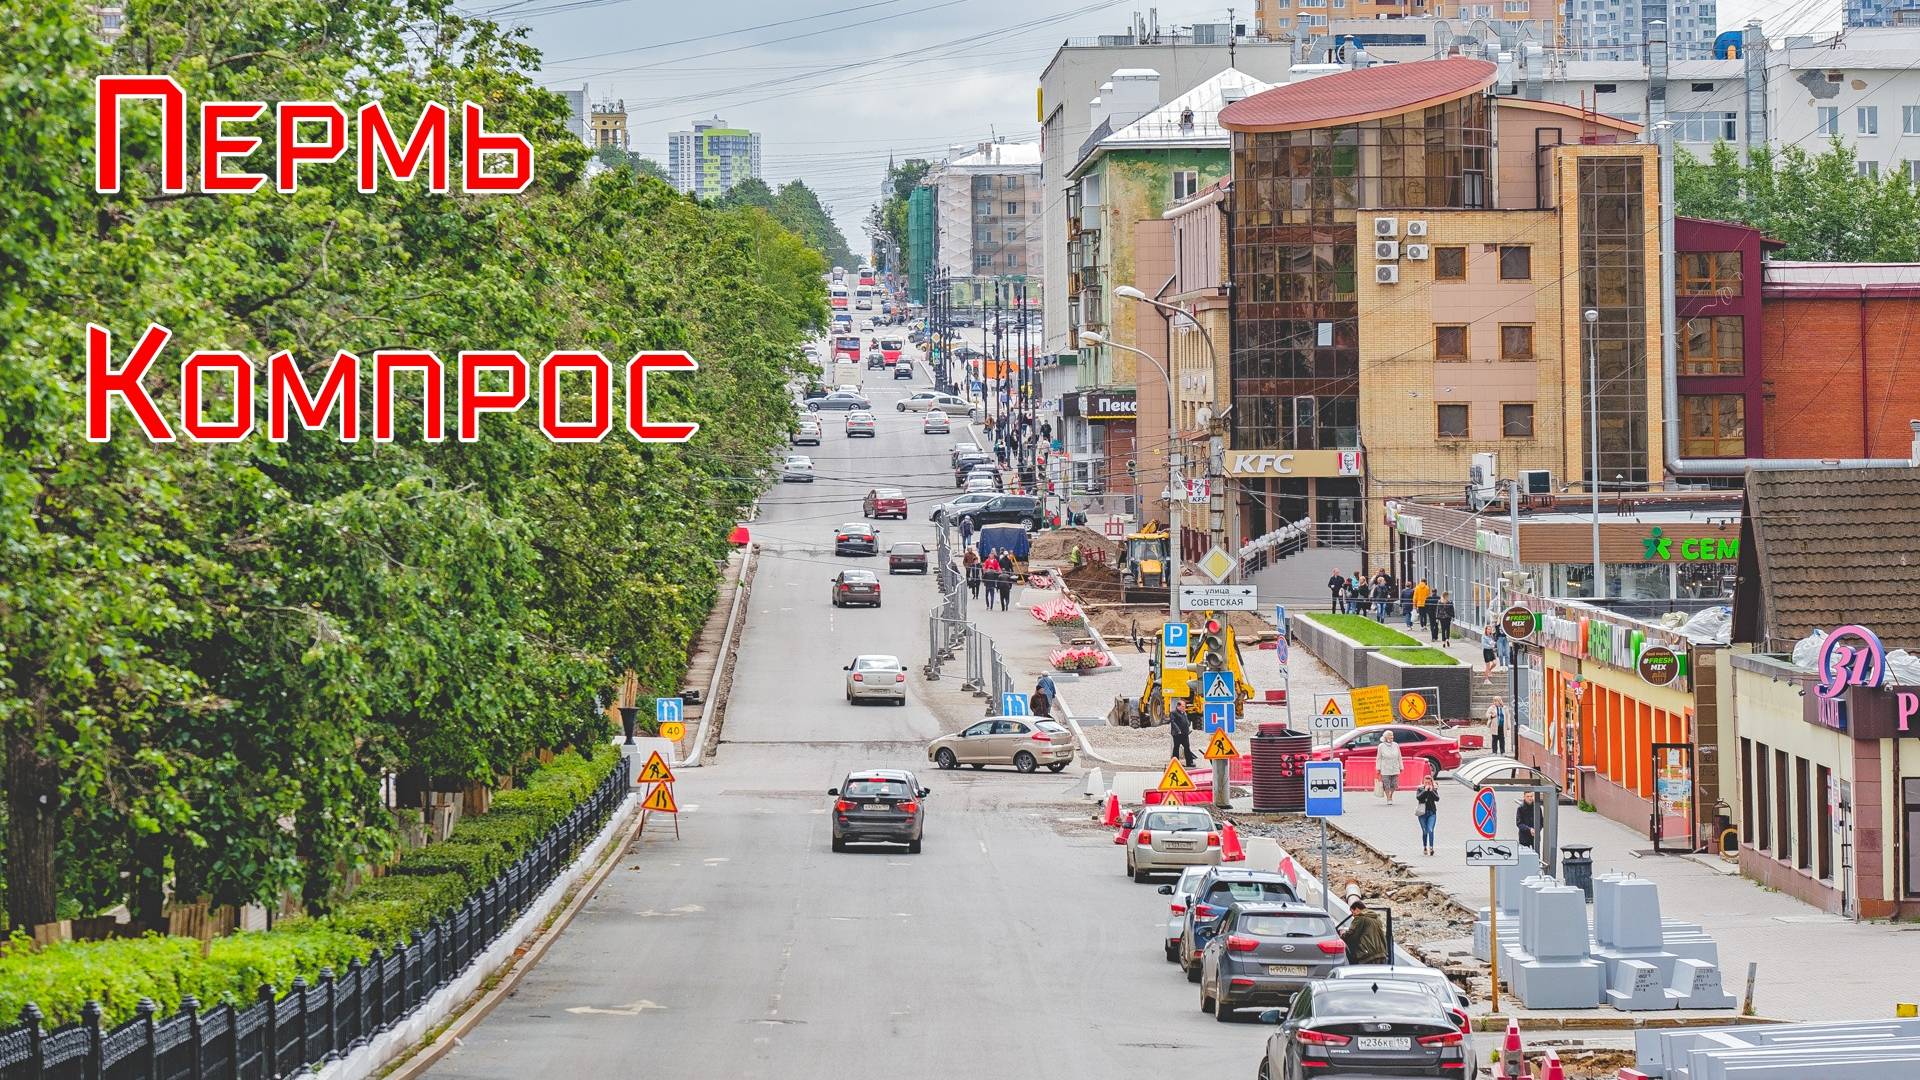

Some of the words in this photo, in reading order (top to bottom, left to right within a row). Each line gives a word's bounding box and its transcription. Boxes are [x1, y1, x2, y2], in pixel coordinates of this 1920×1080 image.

[1232, 454, 1294, 474] KFC
[1643, 657, 1674, 665] #FRESH
[1315, 717, 1349, 728] СТОП
[667, 726, 680, 735] 40
